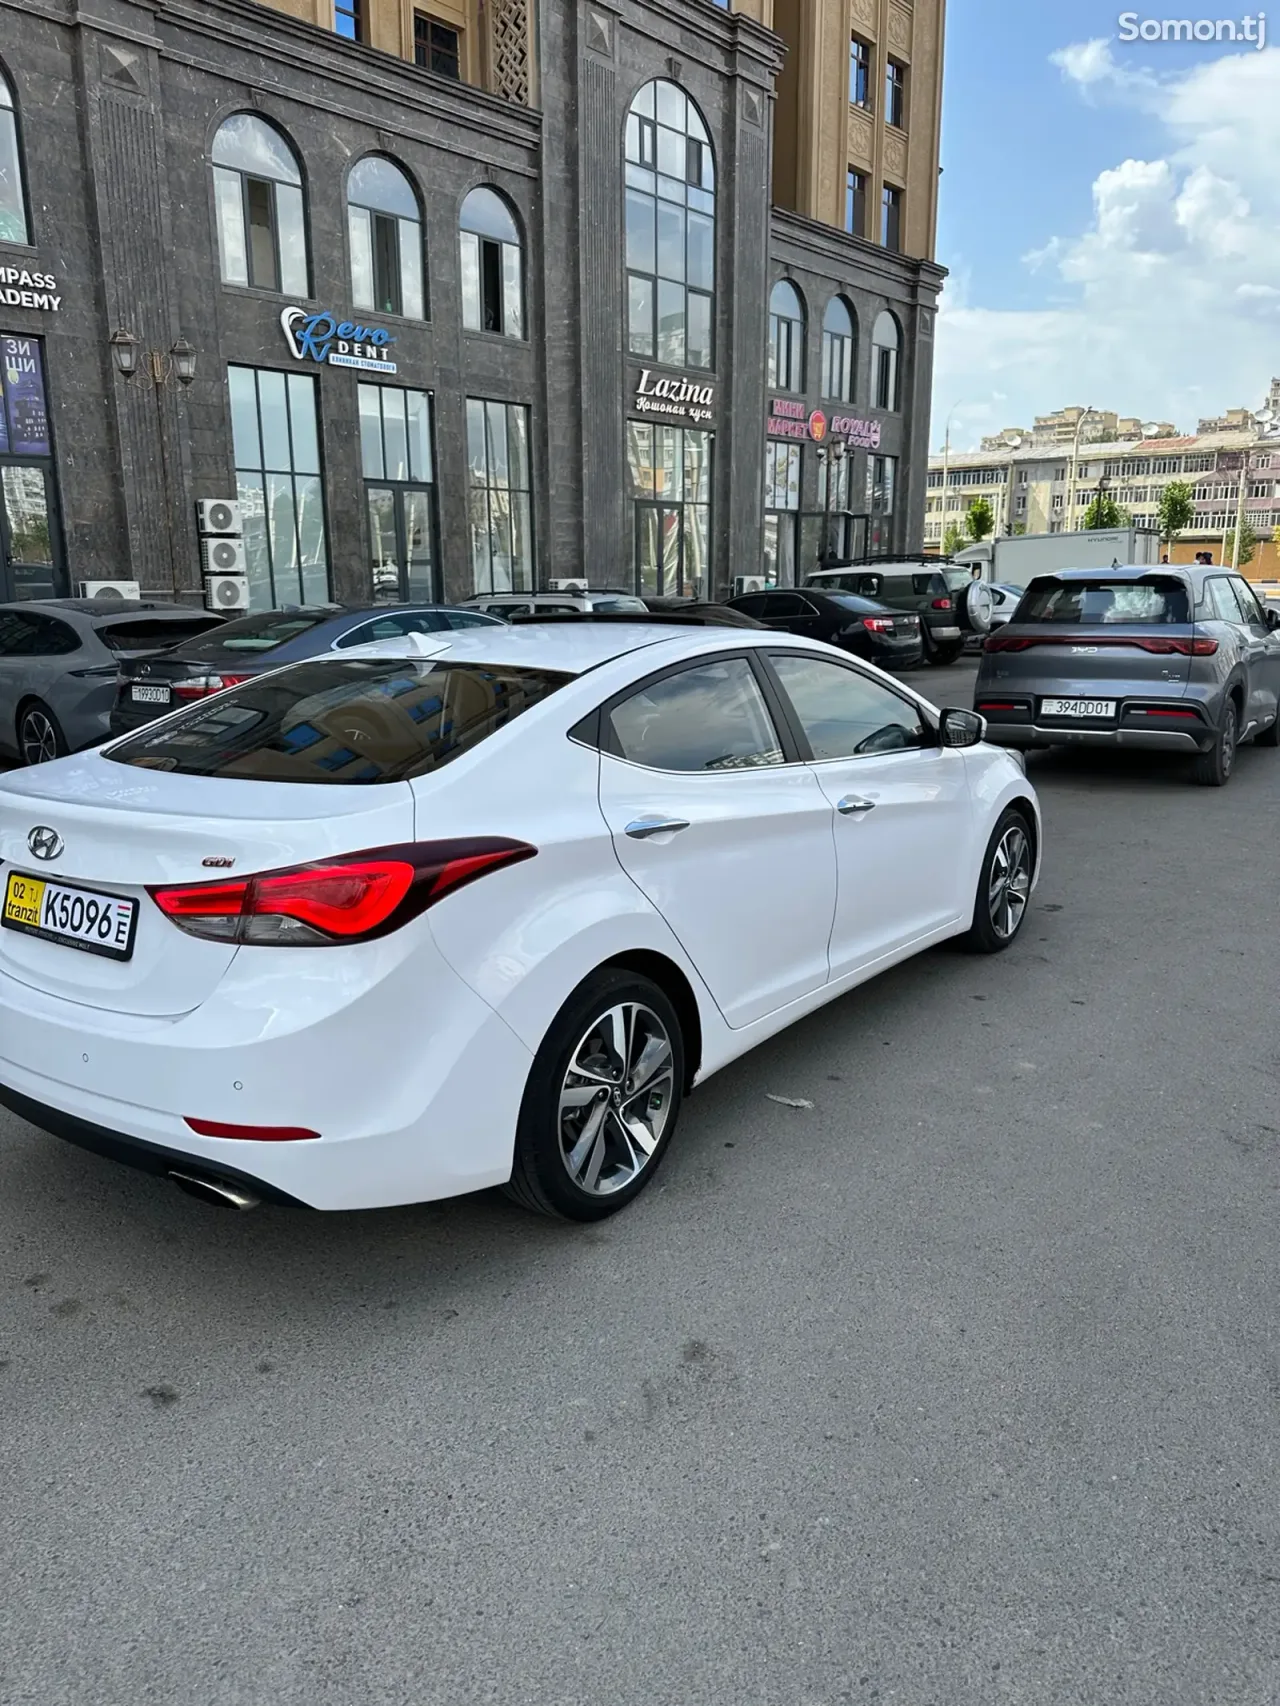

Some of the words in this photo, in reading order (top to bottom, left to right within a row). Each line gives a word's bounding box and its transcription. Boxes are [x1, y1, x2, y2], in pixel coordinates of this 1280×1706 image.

[296, 311, 397, 362] Revo
[337, 340, 389, 361] DENT
[636, 369, 713, 405] Lazina
[636, 397, 686, 415] Кошонаи
[831, 416, 870, 437] ROYAL
[847, 435, 871, 448] FOOD
[1056, 700, 1110, 715] 394DD01
[13, 881, 26, 899] 02
[30, 886, 39, 903] TJ
[7, 900, 38, 924] tranzit
[44, 889, 112, 939] K5096
[115, 921, 127, 944] E
